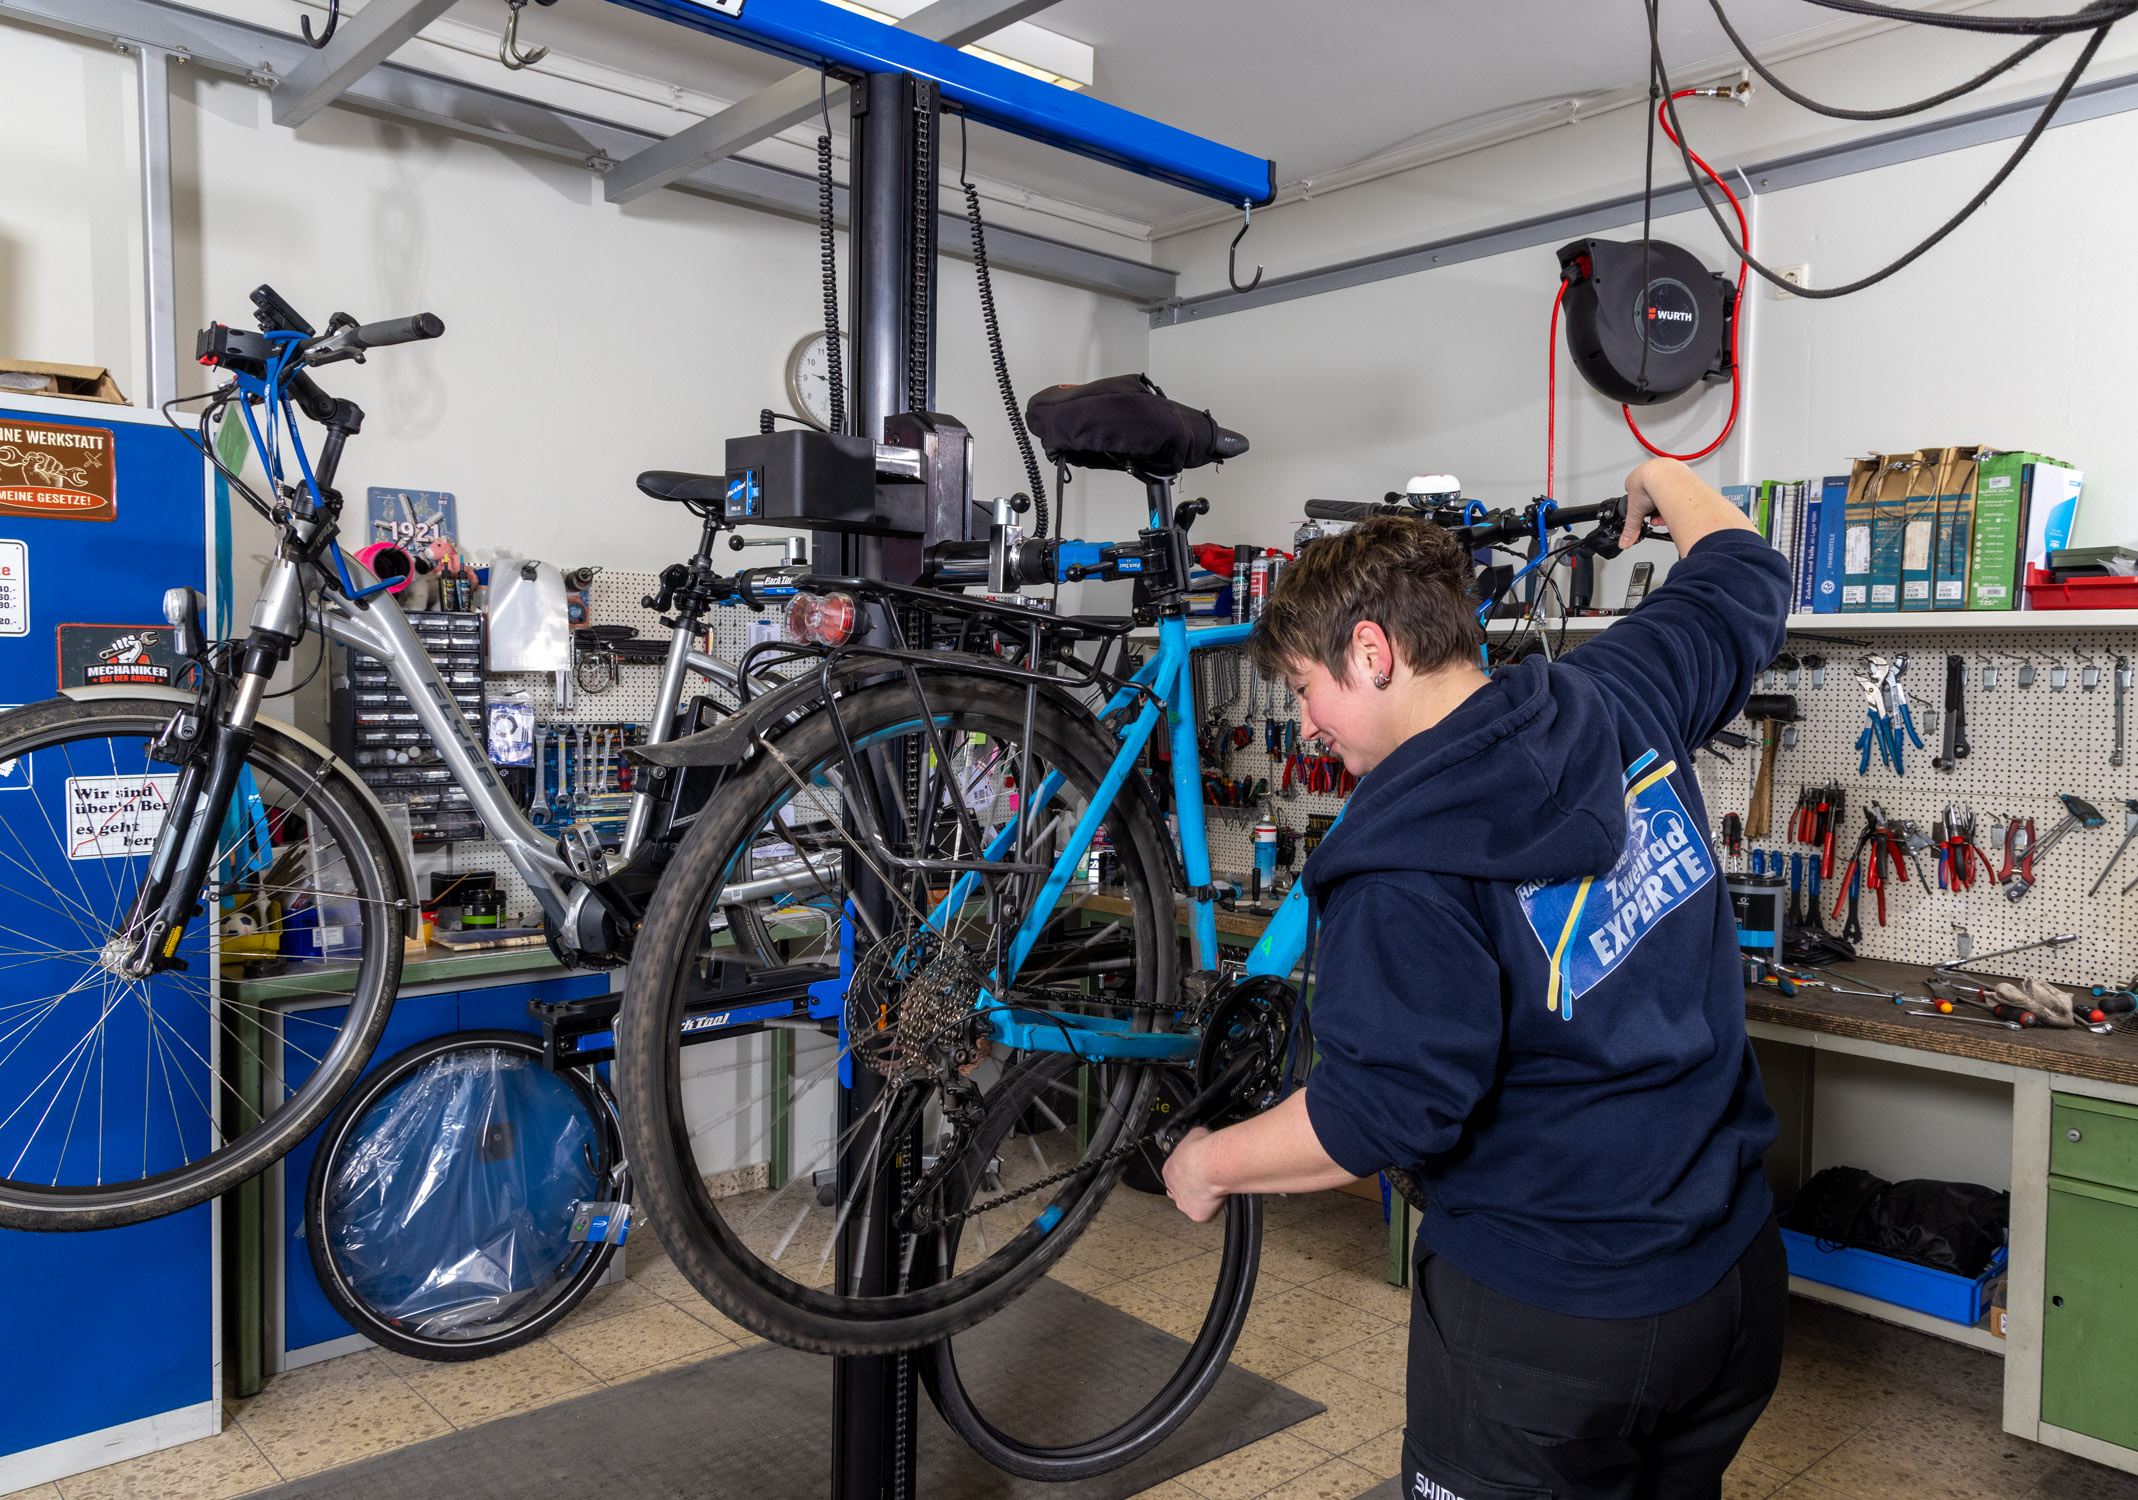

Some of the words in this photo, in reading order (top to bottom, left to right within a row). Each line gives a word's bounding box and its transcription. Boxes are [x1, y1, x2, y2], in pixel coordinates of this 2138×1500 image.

[1657, 310, 1692, 322] WÜRTH
[26, 429, 104, 450] WERKSTATT
[37, 493, 91, 506] GESETZE!
[389, 520, 440, 542] 1921
[87, 665, 168, 677] MECHANIKER
[100, 675, 113, 683] BEI
[114, 675, 129, 683] DER
[130, 675, 156, 683] ARBEIT
[74, 788, 109, 800] Wir
[115, 786, 153, 798] sind
[75, 802, 134, 814] über'n
[141, 800, 169, 812] Ber
[76, 826, 94, 835] es
[99, 822, 140, 836] geht
[1605, 817, 1689, 911] Zweirad
[1588, 846, 1706, 966] EXPERTE
[696, 1013, 730, 1028] Tool
[1415, 1471, 1466, 1500] SHIM
